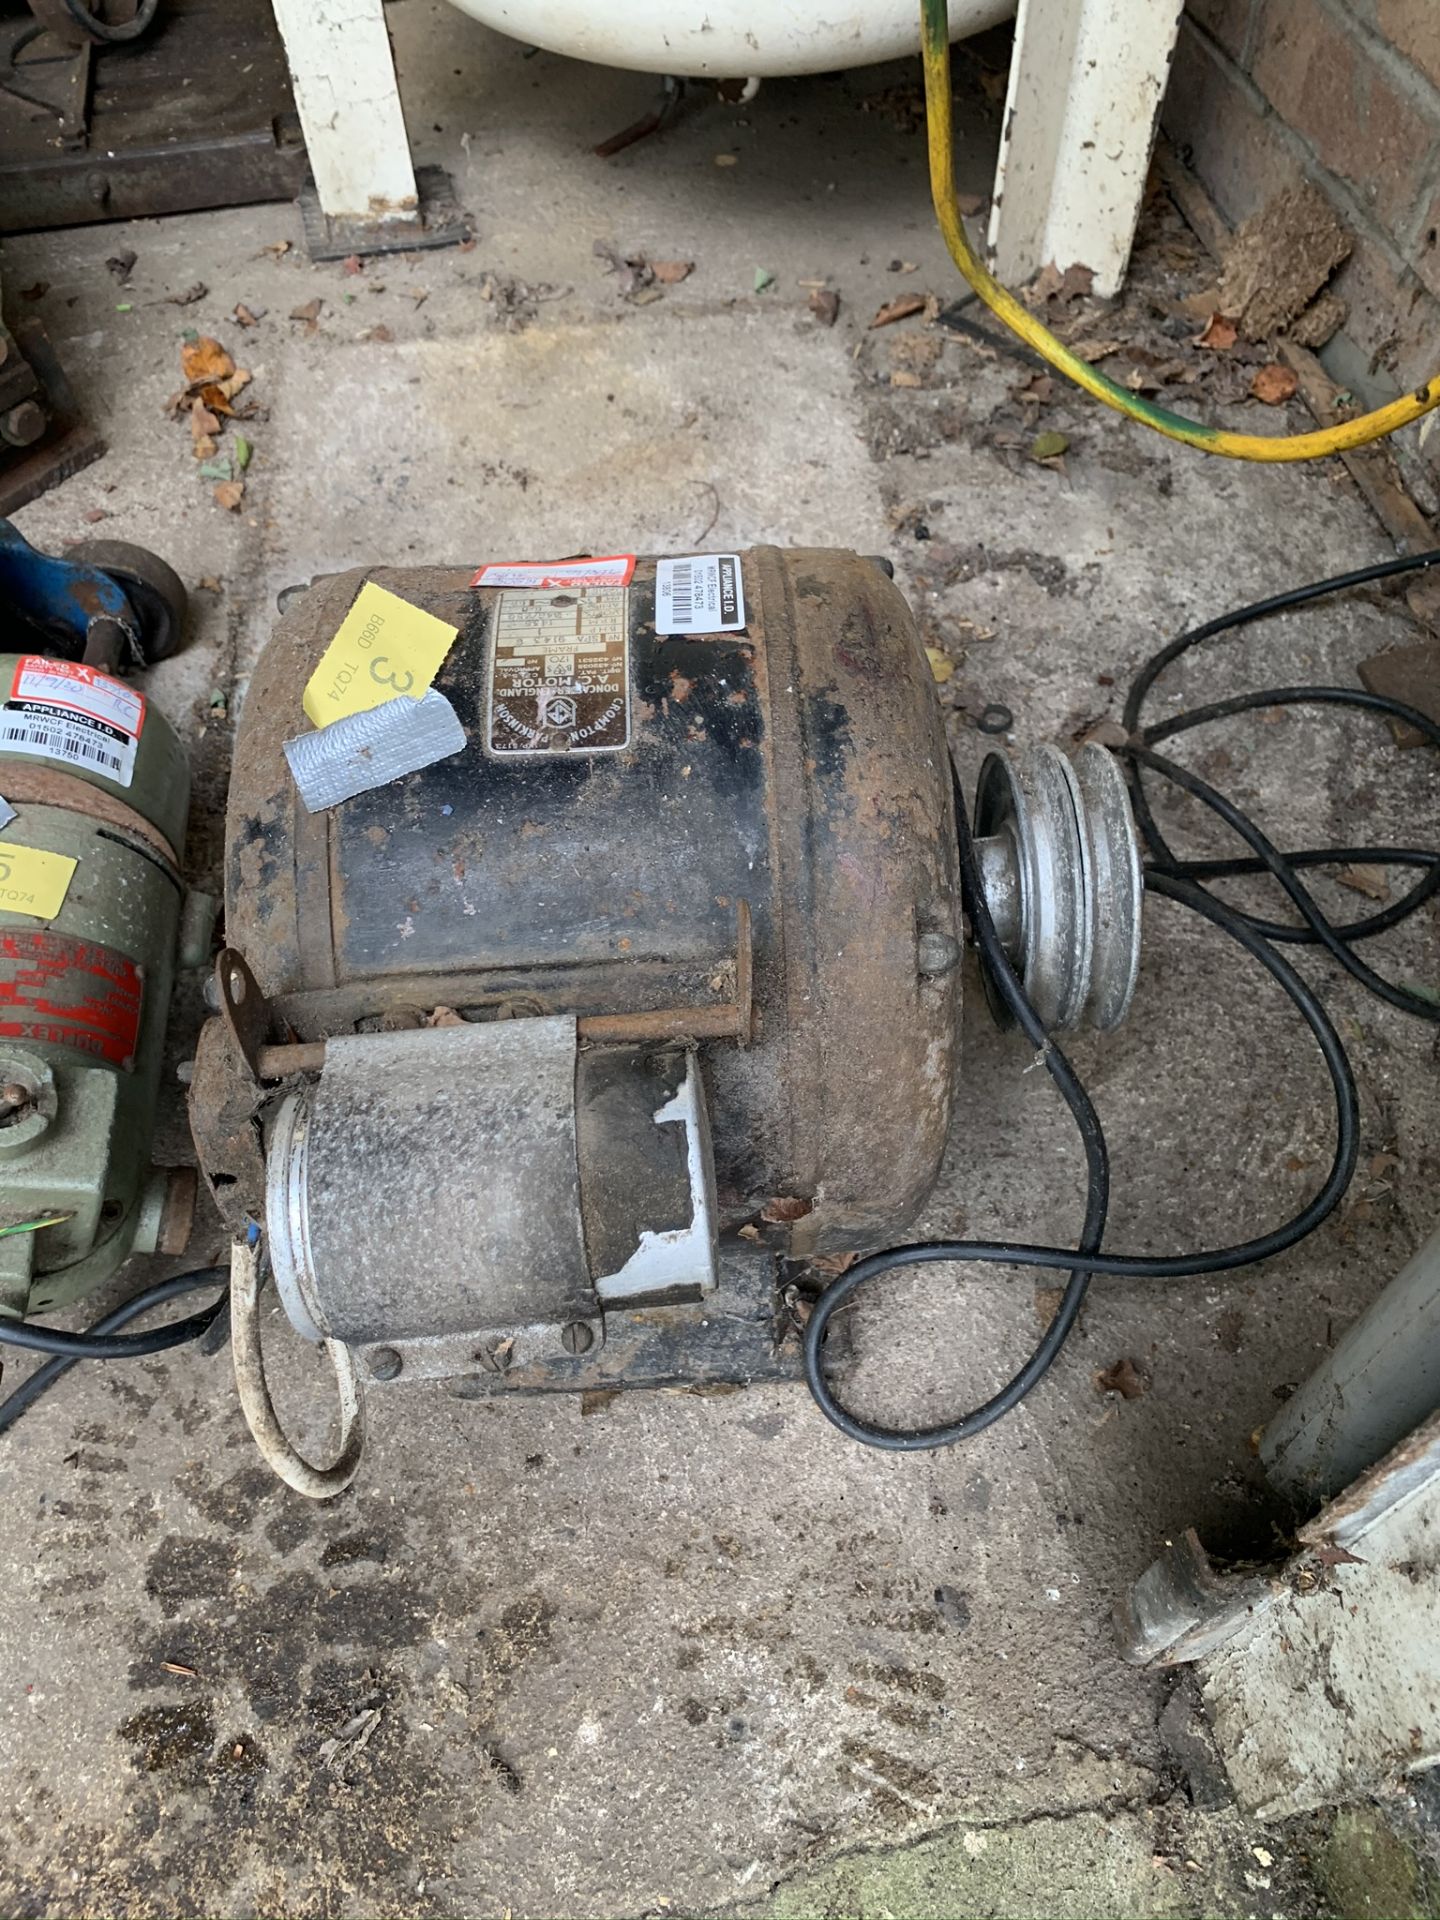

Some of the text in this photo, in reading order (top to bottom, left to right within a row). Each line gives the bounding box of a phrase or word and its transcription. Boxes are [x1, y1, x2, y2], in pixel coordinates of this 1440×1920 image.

[722, 564, 734, 615] APPLIANCE I.D.
[358, 614, 385, 650] B66D
[327, 662, 359, 702] TQ74
[370, 656, 414, 692] 3
[512, 674, 608, 687] A.C. MOTOR
[22, 704, 116, 737] APPLIANCE I.D.
[24, 714, 110, 744] MRWCF Electrical
[29, 723, 63, 735] 01502
[496, 703, 548, 743] PARKINSON
[570, 698, 624, 742] CROMPTON
